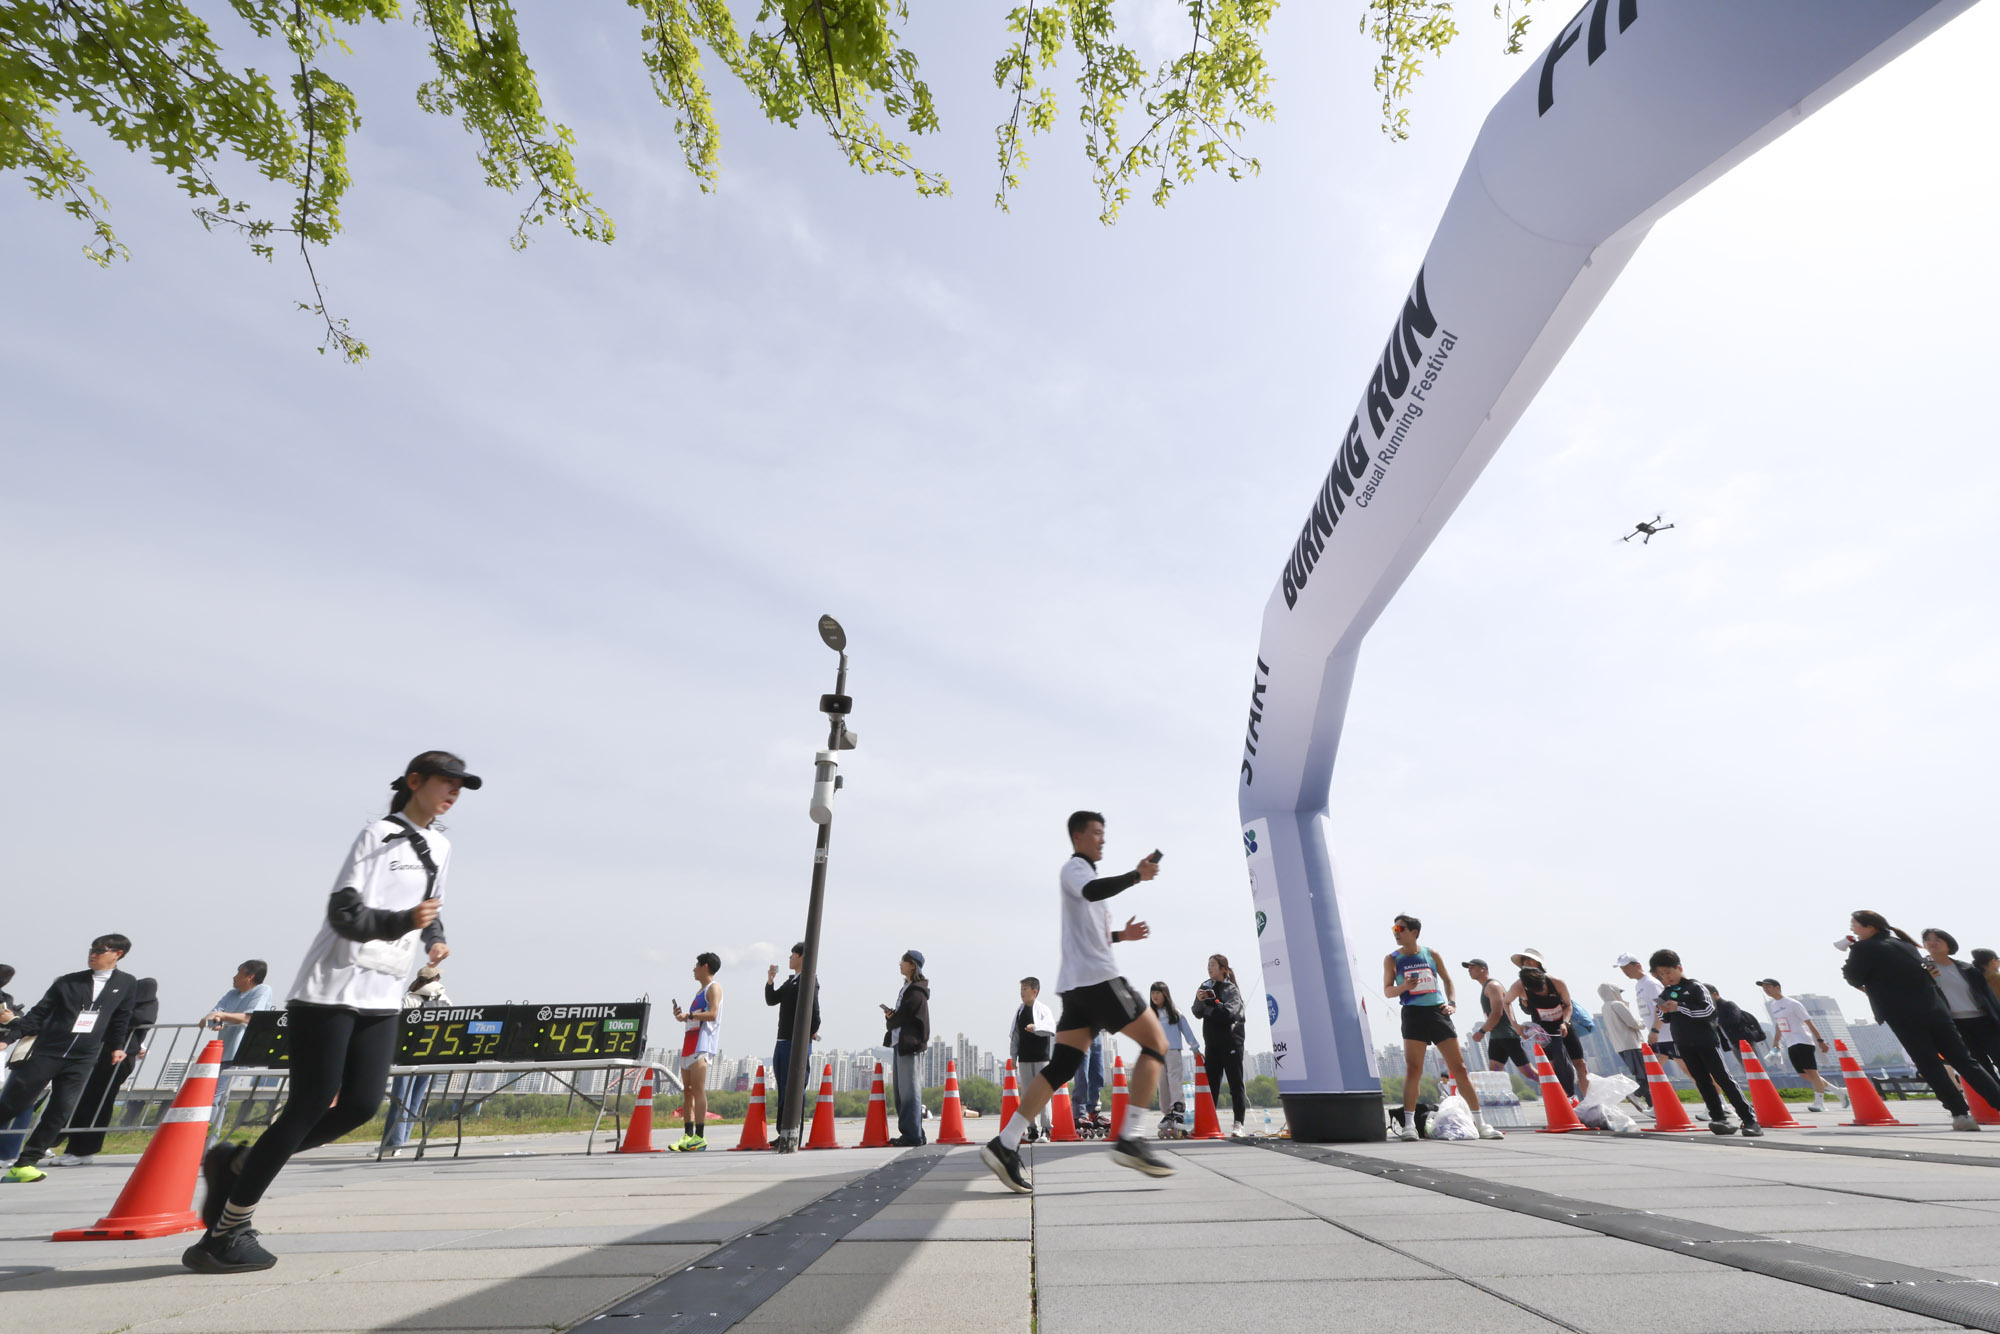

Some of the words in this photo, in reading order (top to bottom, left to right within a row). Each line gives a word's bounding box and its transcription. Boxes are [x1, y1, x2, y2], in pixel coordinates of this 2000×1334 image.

[1355, 464, 1387, 510] Casual
[1378, 400, 1424, 466] Running
[1410, 330, 1459, 402] Festival
[1282, 414, 1370, 612] BURNING
[1367, 262, 1438, 440] RUN
[423, 1008, 484, 1021] SAMIK
[553, 1005, 617, 1019] SAMIK
[475, 1022, 496, 1033] 7km
[608, 1020, 634, 1030] 10km
